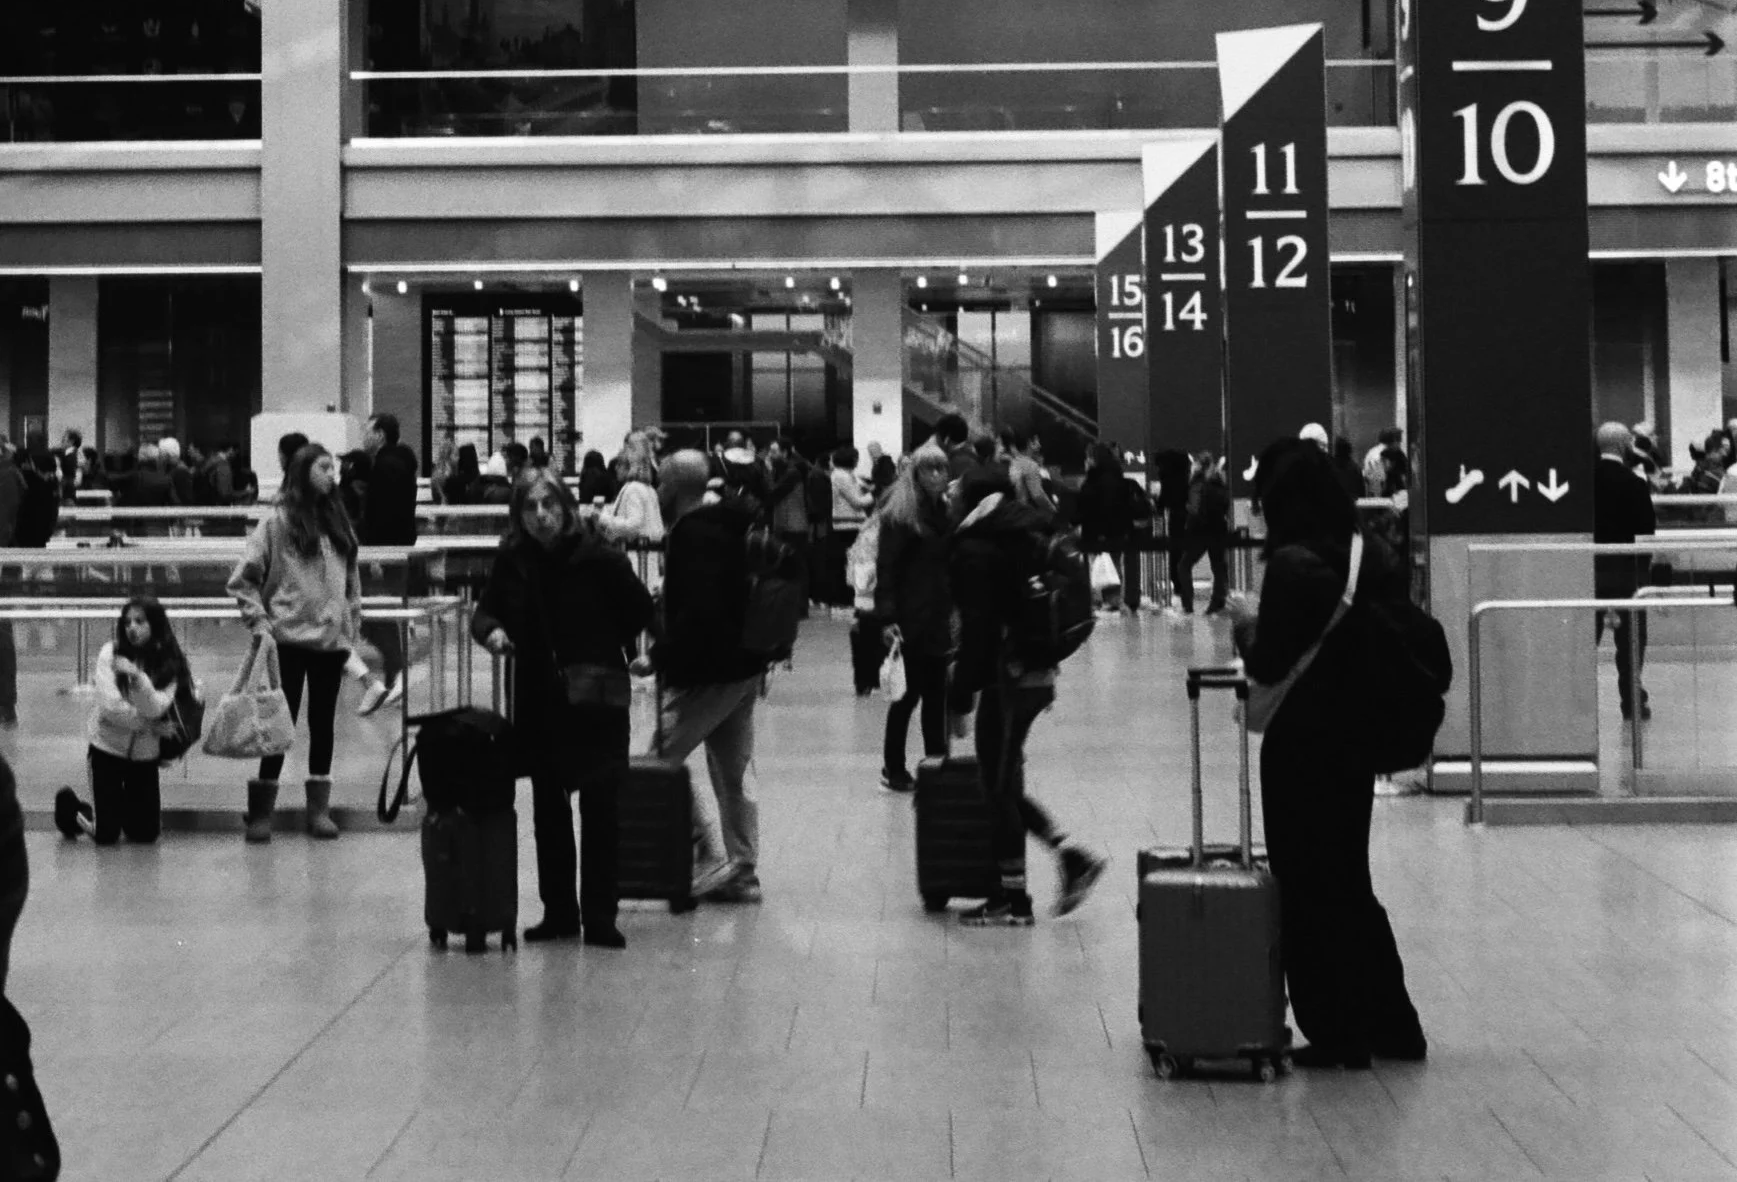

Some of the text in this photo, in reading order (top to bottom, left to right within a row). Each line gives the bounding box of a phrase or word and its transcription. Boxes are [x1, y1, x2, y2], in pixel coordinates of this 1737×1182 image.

[1455, 101, 1555, 185] 10
[1250, 142, 1298, 195] 11
[1163, 223, 1205, 263] 13
[1248, 235, 1308, 288] 12
[1110, 274, 1142, 307] 15
[1162, 291, 1208, 330] 14
[1111, 324, 1144, 358] 16
